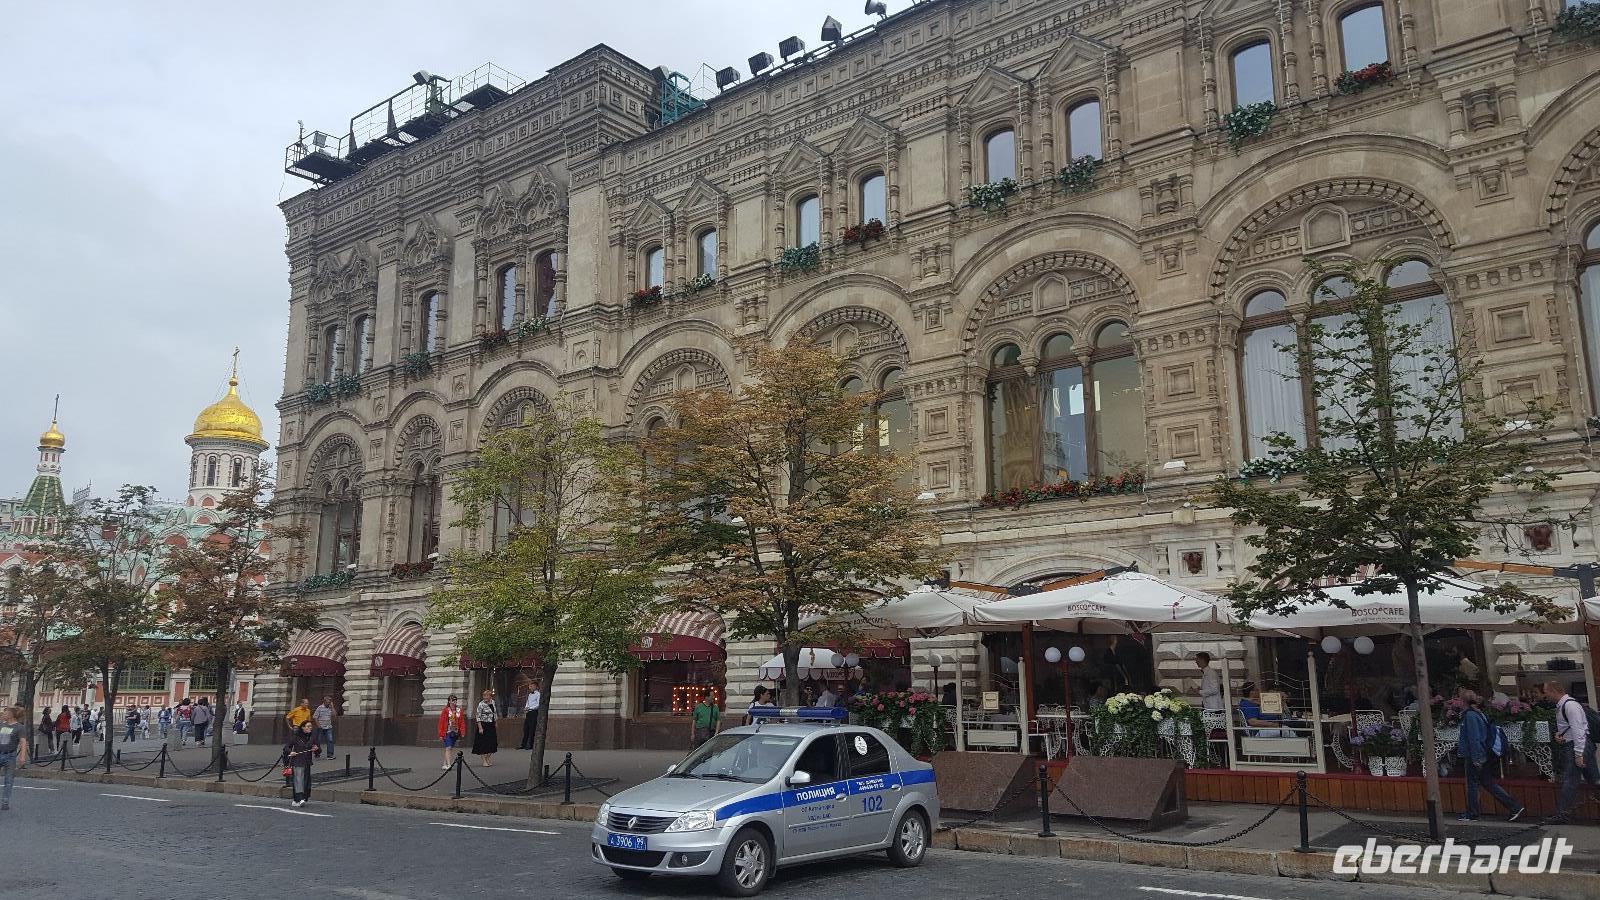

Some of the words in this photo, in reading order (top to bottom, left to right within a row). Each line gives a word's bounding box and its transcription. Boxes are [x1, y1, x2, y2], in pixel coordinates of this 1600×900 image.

[796, 787, 836, 801] ПОЛИЦИЯ
[862, 795, 883, 812] 102
[616, 835, 633, 848] 3906
